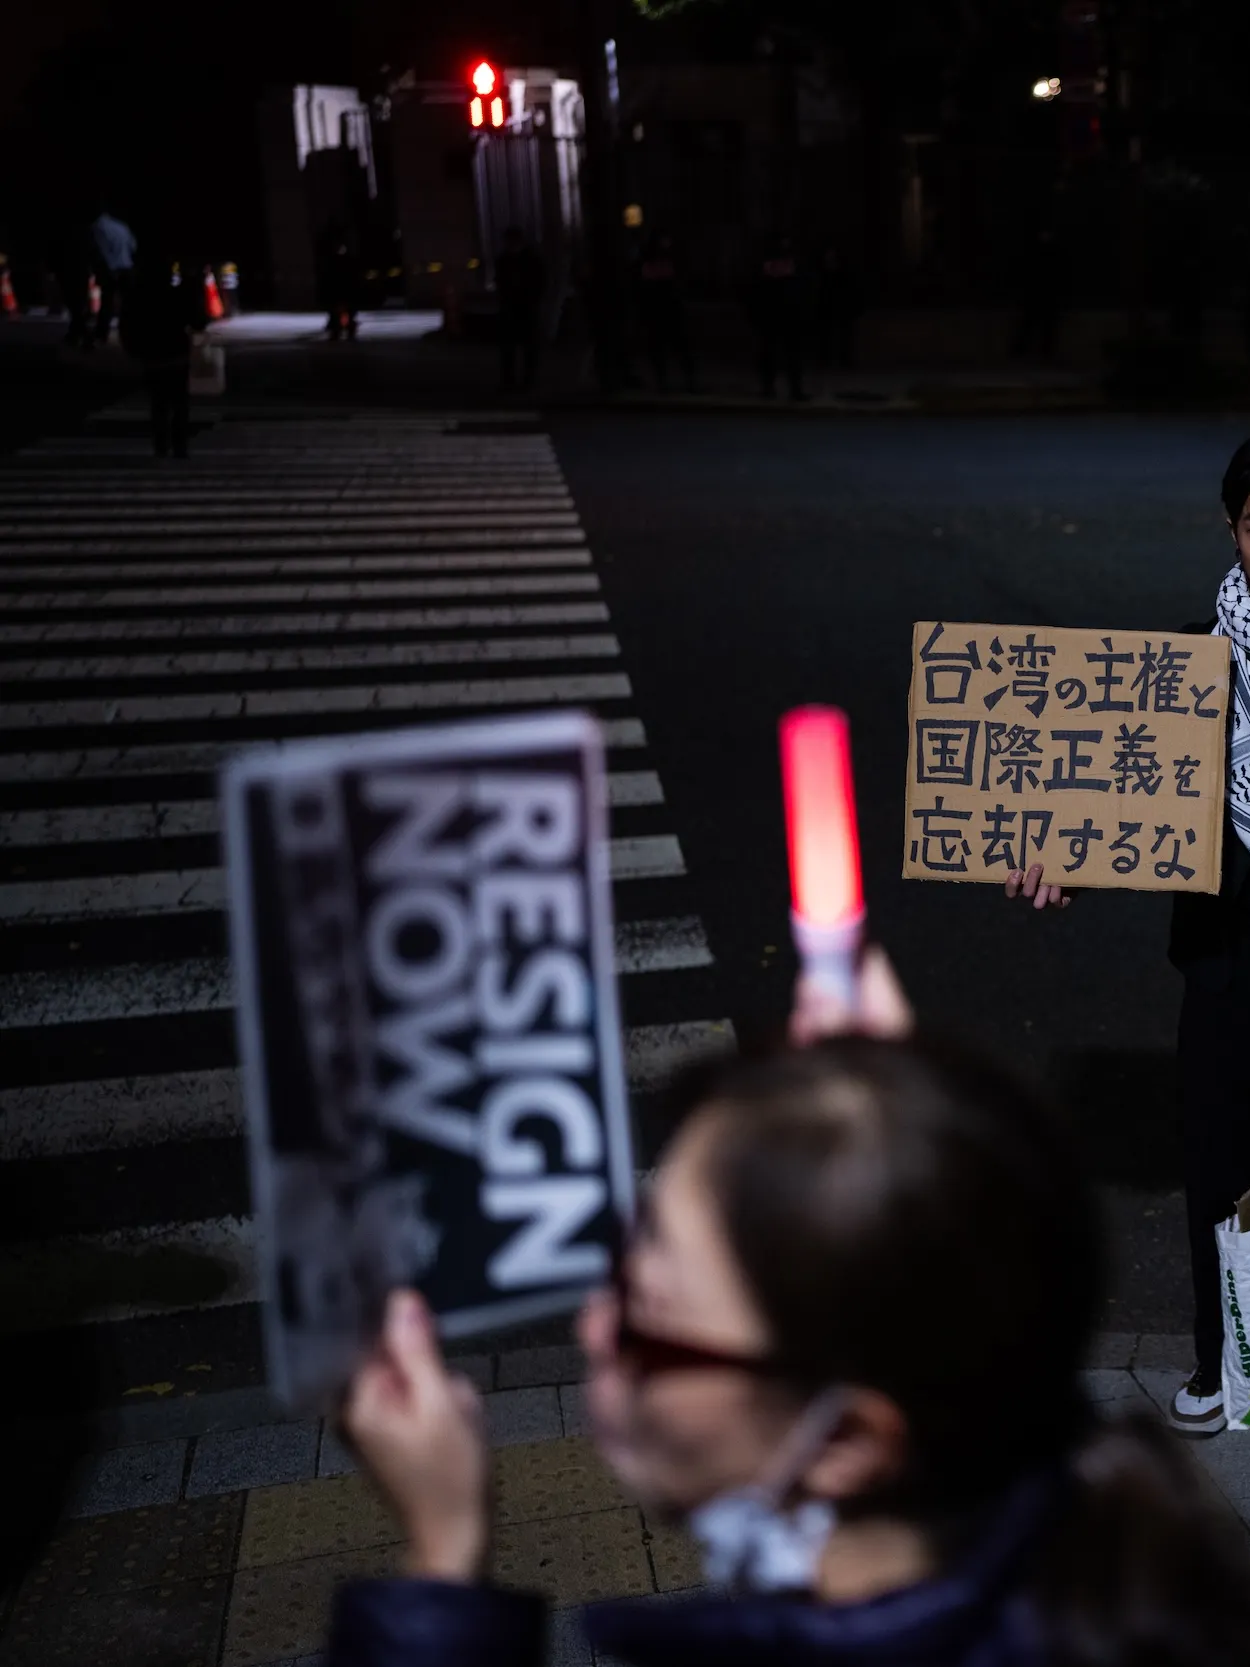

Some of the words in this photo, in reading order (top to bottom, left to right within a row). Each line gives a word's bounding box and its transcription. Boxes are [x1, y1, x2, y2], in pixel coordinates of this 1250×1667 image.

[920, 622, 1220, 718] 台湾の主権と
[916, 718, 1201, 798] 国際正義を
[910, 796, 1196, 880] 忘却するな
[357, 770, 483, 1160] NOW
[470, 770, 612, 1291] RESIGN
